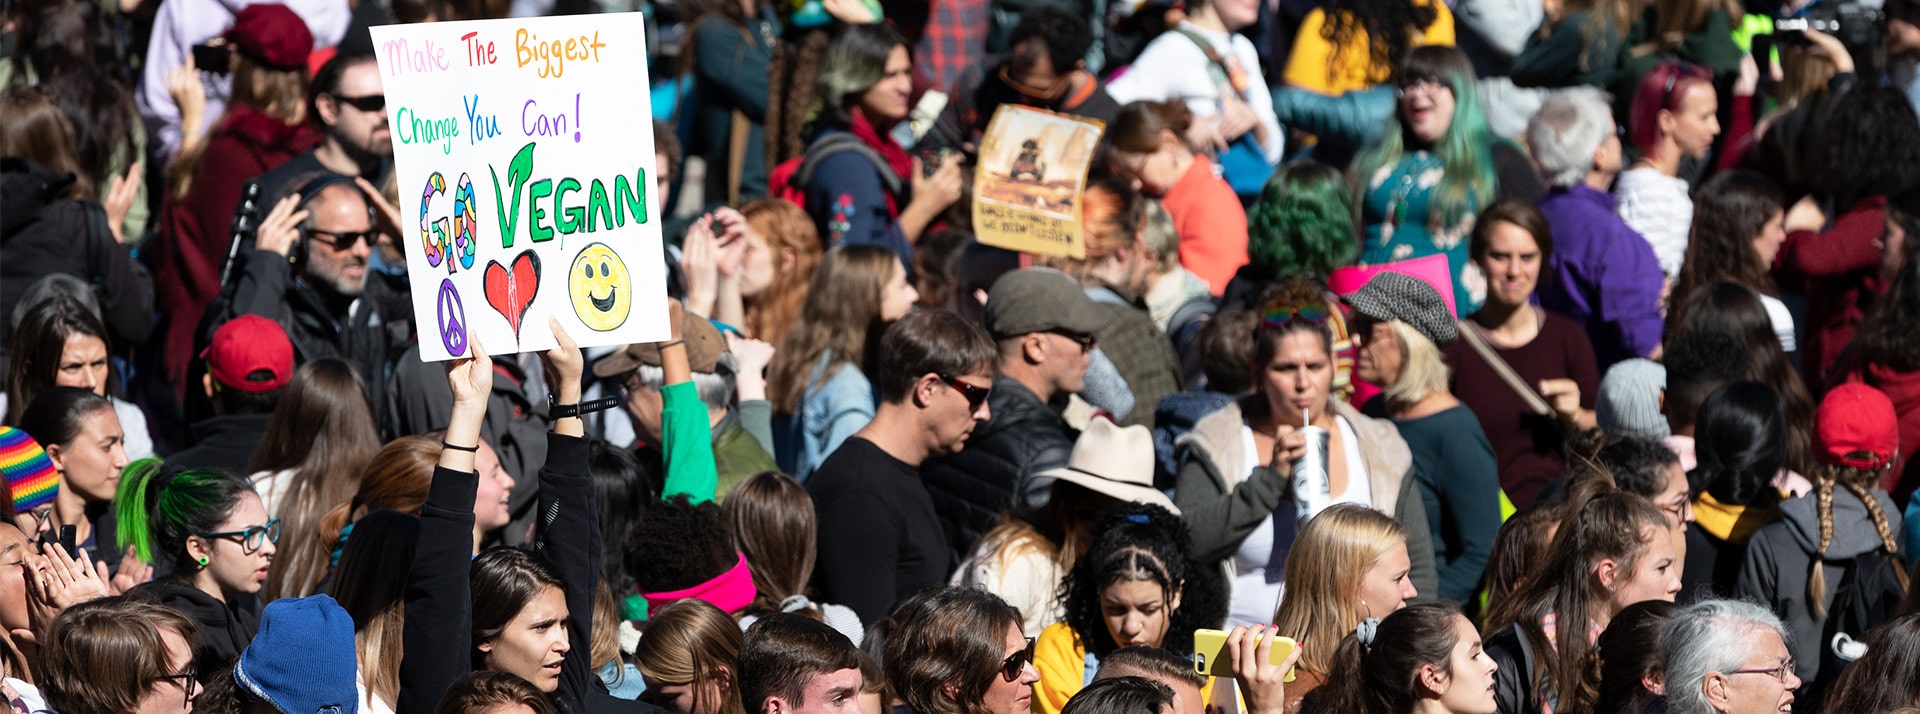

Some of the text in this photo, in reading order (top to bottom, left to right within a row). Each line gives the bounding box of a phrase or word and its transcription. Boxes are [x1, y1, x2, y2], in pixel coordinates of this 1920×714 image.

[383, 28, 606, 78] Make The Biggest
[397, 93, 580, 155] Change You Can!
[420, 142, 648, 275] GO VEGAN
